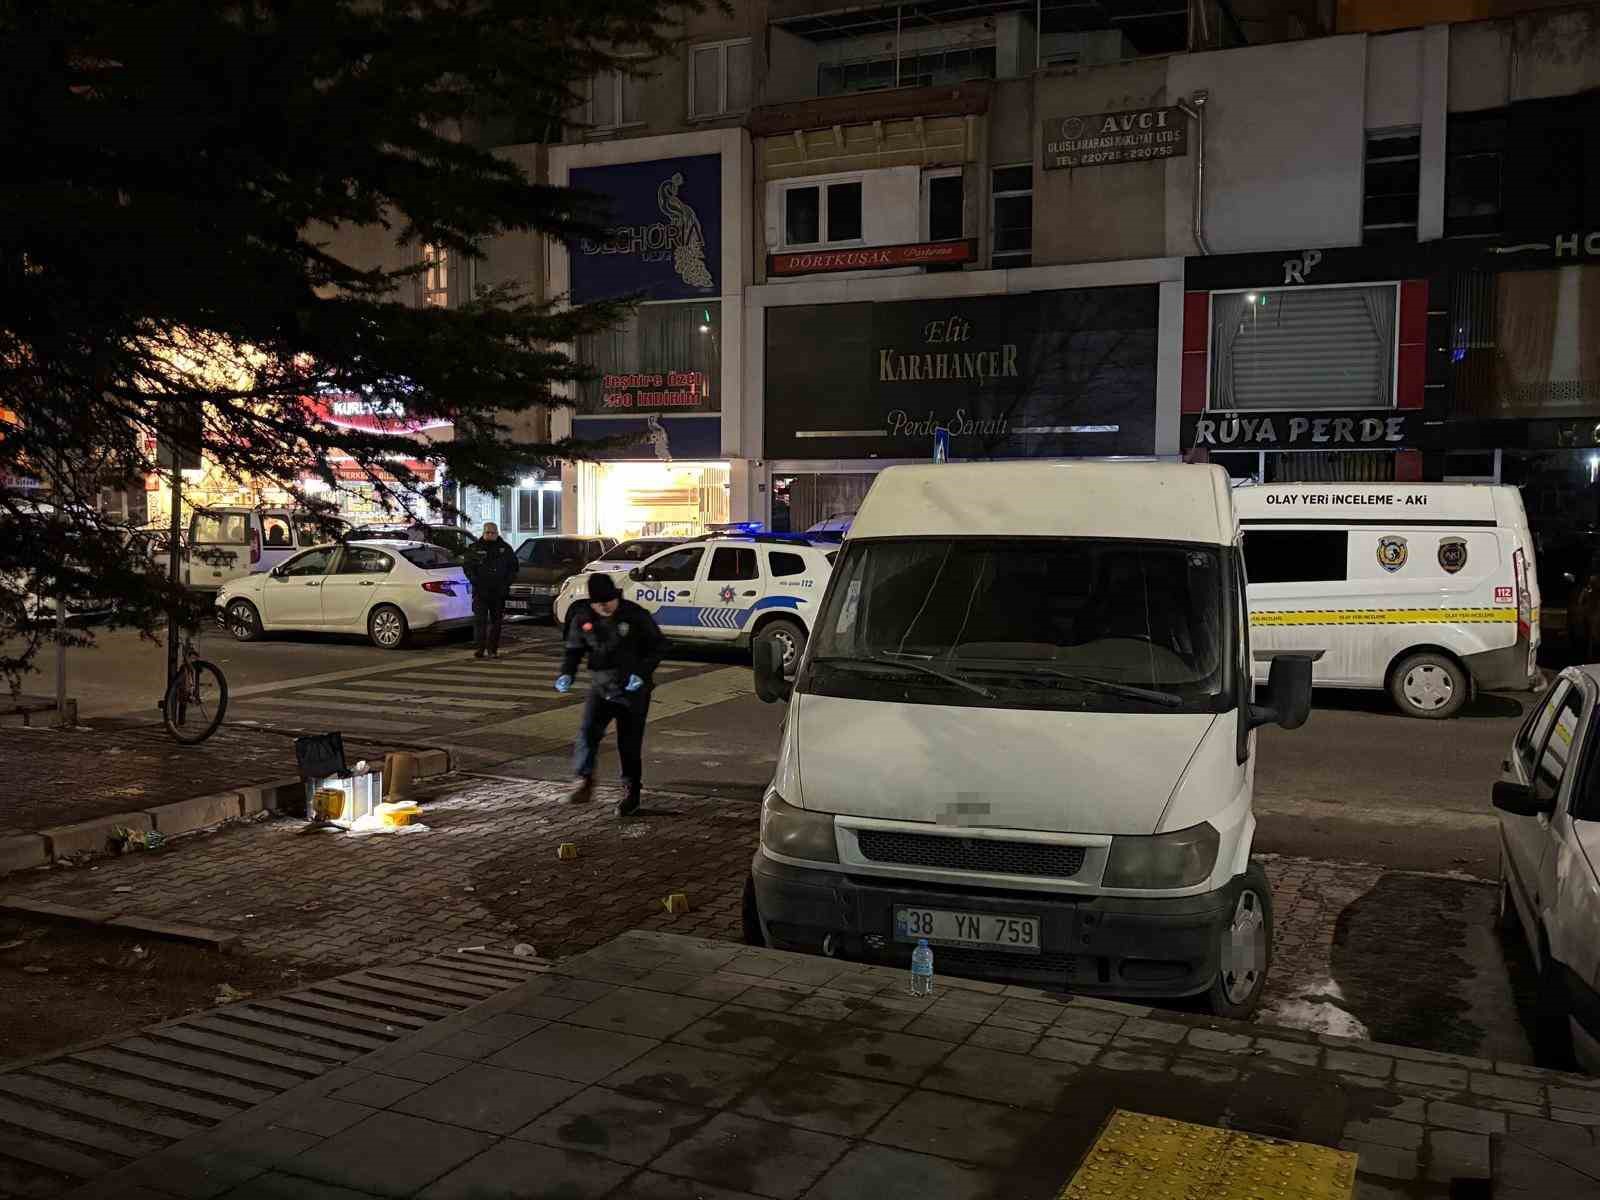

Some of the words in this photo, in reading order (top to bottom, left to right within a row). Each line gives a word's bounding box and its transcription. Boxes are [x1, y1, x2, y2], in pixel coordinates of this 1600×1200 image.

[1101, 111, 1169, 133] AVCI
[1282, 250, 1323, 284] RP
[922, 314, 972, 344] Elit
[1196, 413, 1277, 443] RÜYA
[1289, 416, 1405, 443] PERDE
[1266, 494, 1298, 505] OLAY
[636, 586, 676, 602] POLİS
[801, 579, 814, 588] 112
[1497, 588, 1511, 597] 112
[910, 911, 934, 934] 38
[954, 915, 981, 939] YN
[996, 919, 1034, 944] 759
